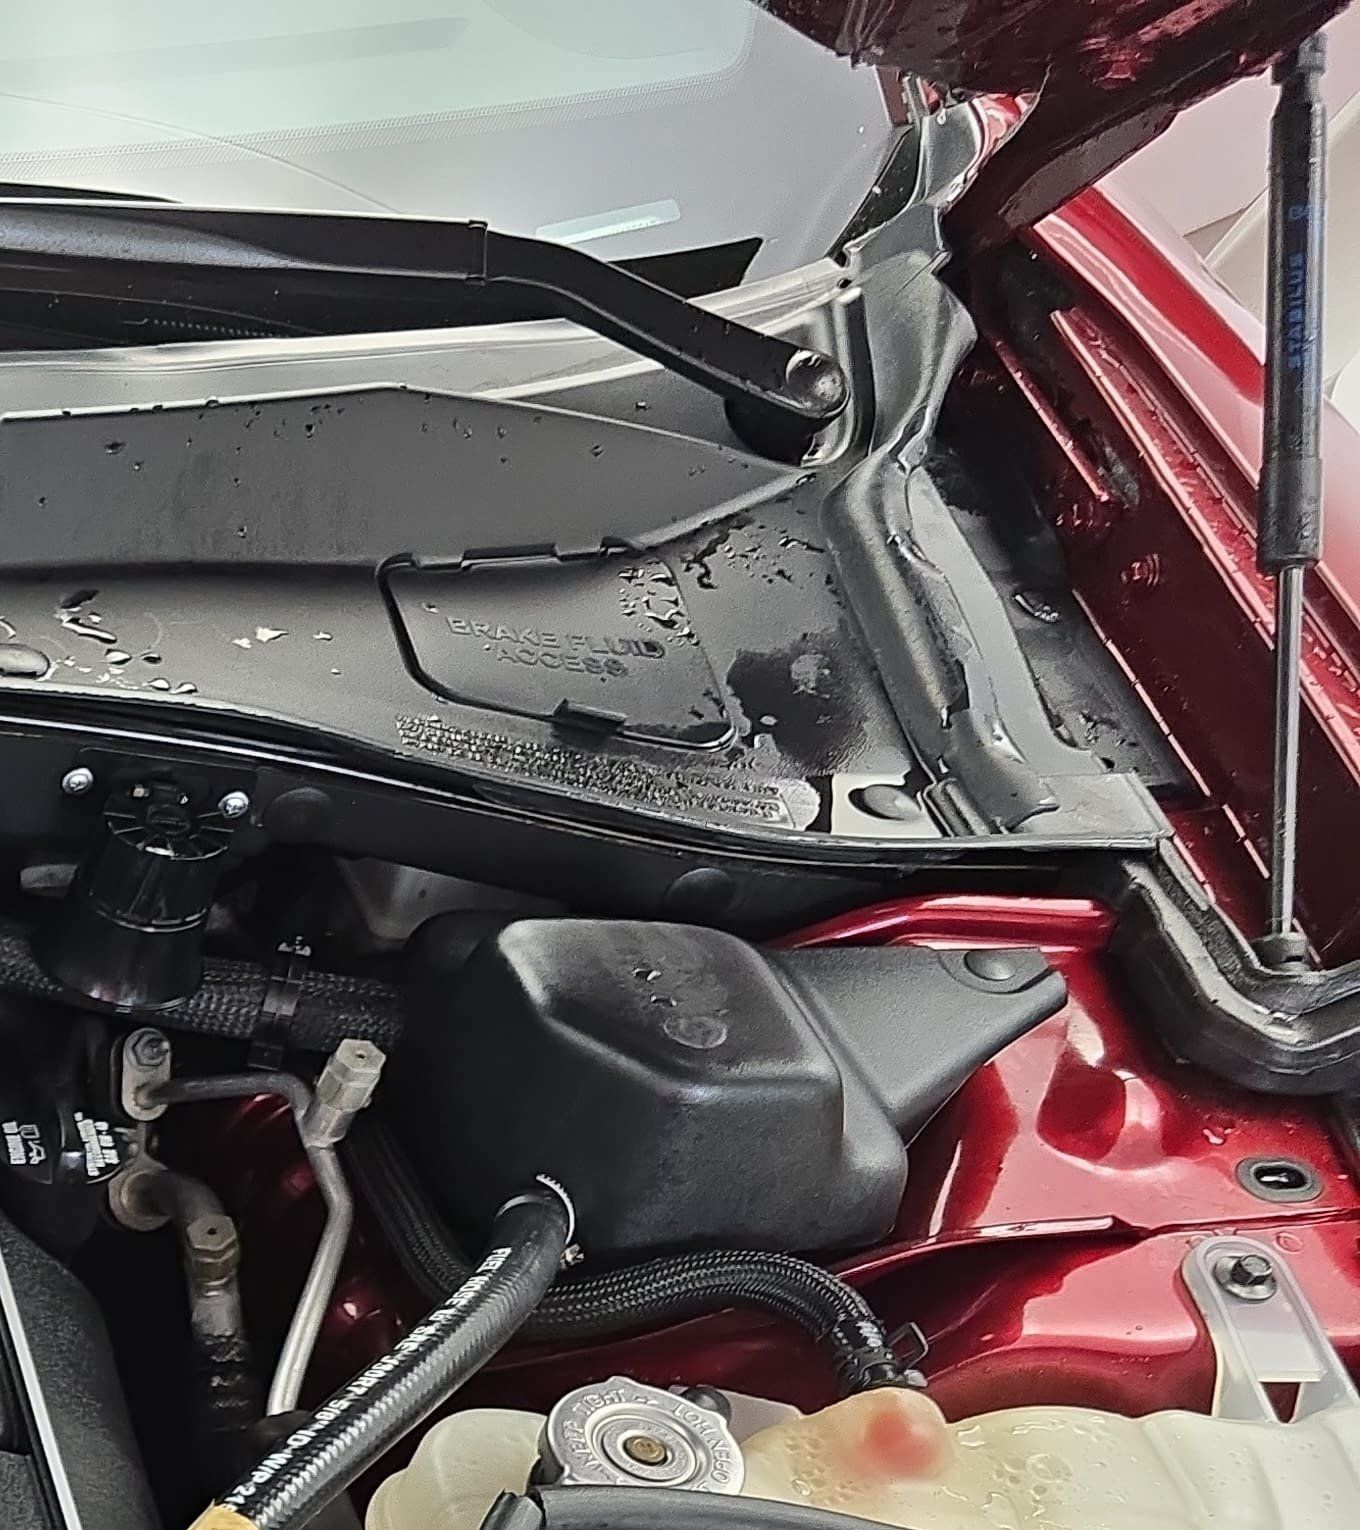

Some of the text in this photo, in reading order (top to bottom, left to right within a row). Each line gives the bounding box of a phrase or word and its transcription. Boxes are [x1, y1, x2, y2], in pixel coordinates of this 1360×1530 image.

[445, 616, 666, 659] BRAKE FLUID
[497, 648, 629, 678] ACCESS
[475, 1247, 512, 1275] FUEL
[445, 1275, 490, 1306] HOSE
